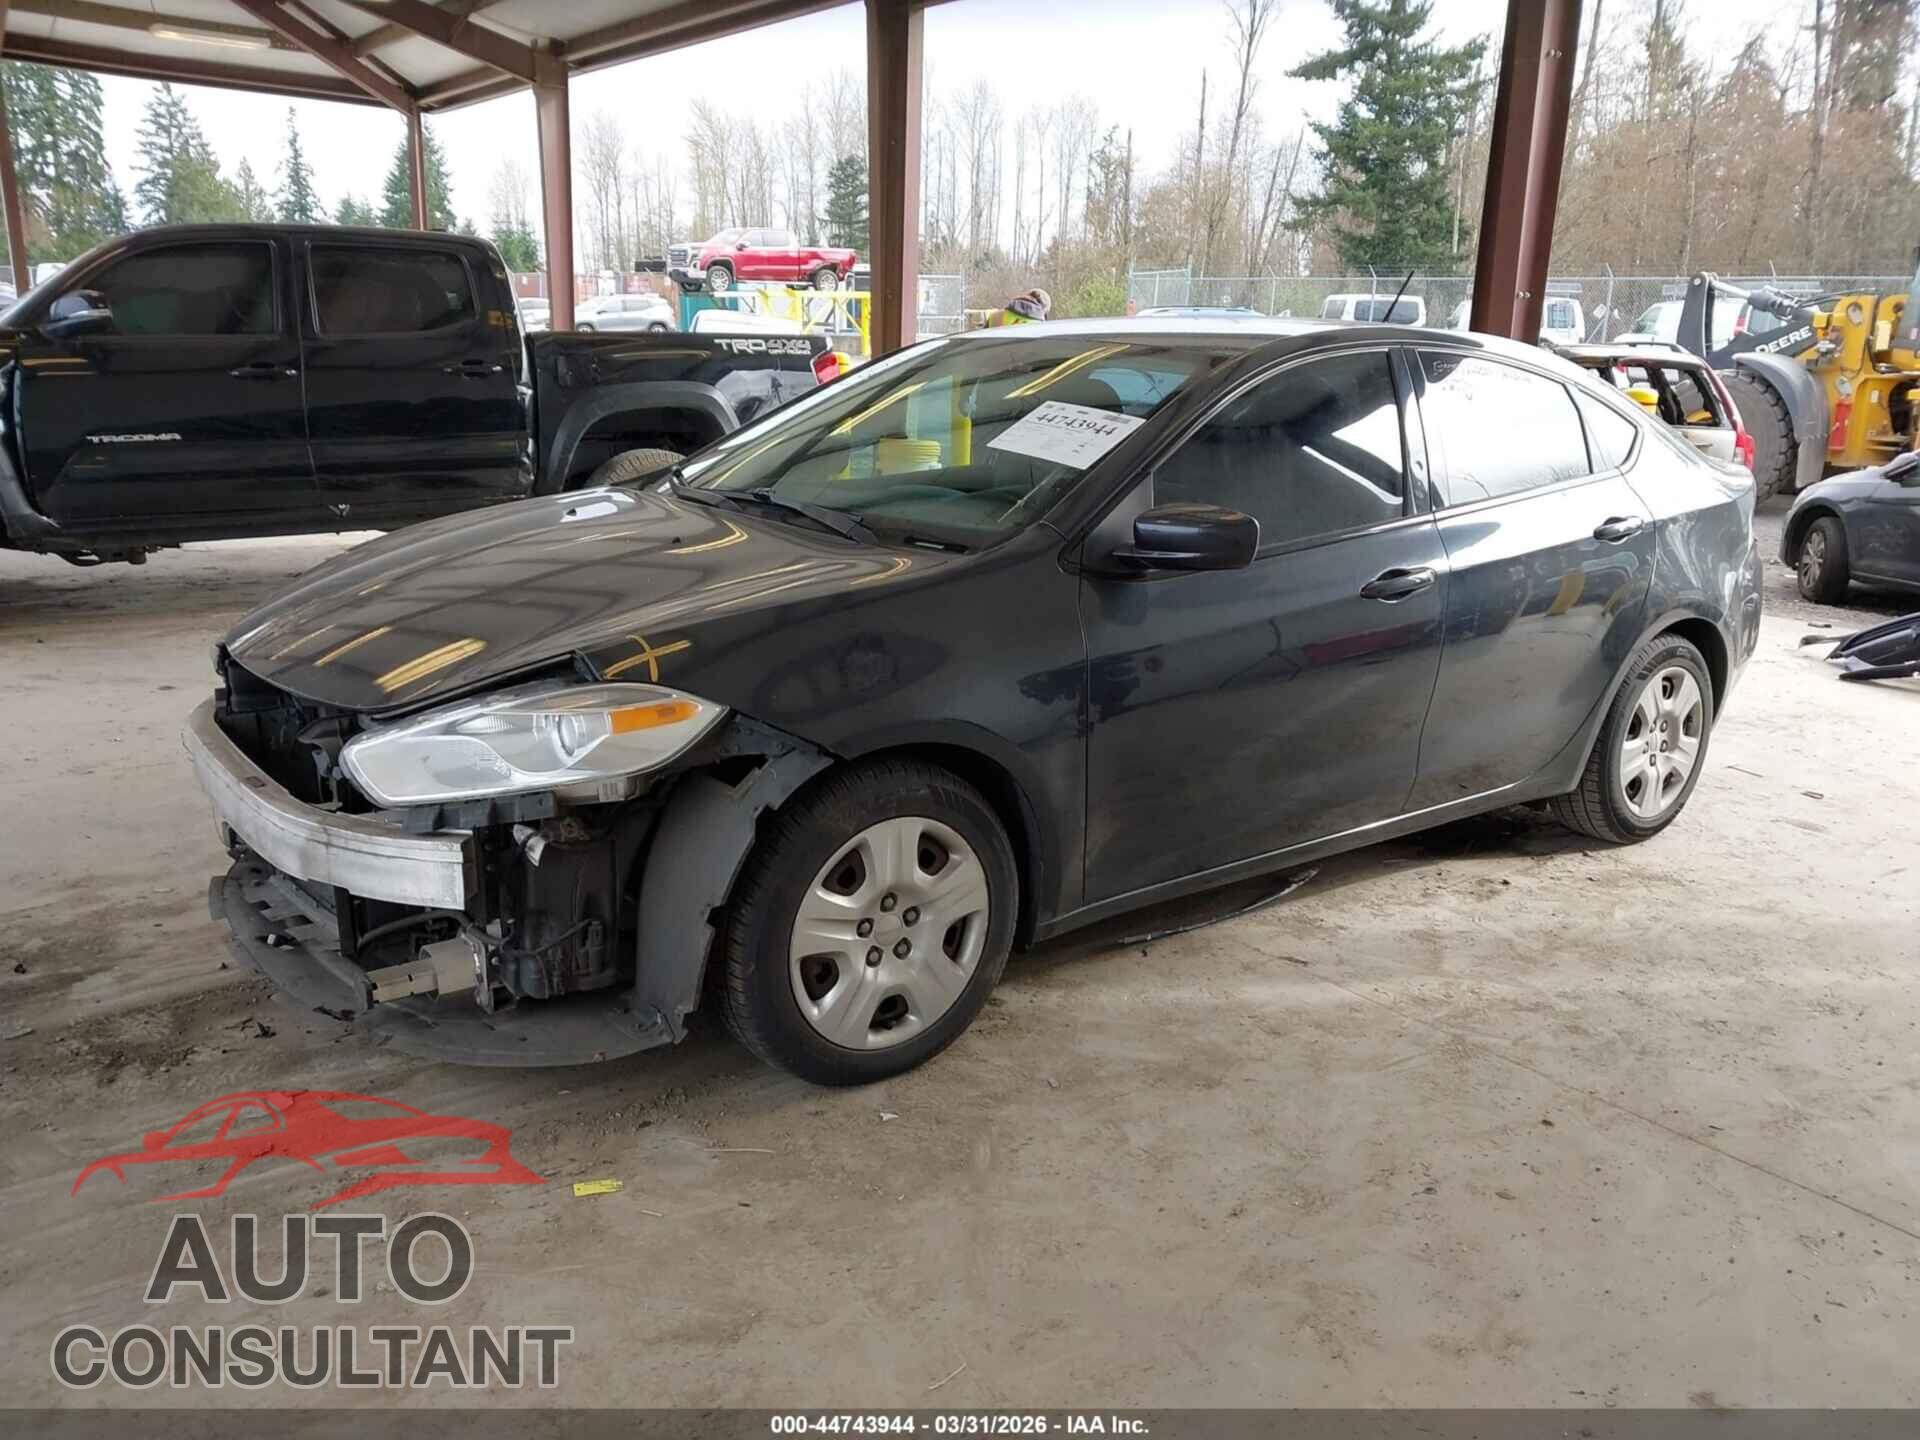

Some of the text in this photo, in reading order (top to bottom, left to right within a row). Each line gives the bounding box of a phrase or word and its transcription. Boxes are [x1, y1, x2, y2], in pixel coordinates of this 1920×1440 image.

[713, 339, 767, 354] TRD
[1755, 325, 1812, 352] DEERE
[1036, 413, 1118, 436] 44743944
[86, 433, 182, 443] TACOMA
